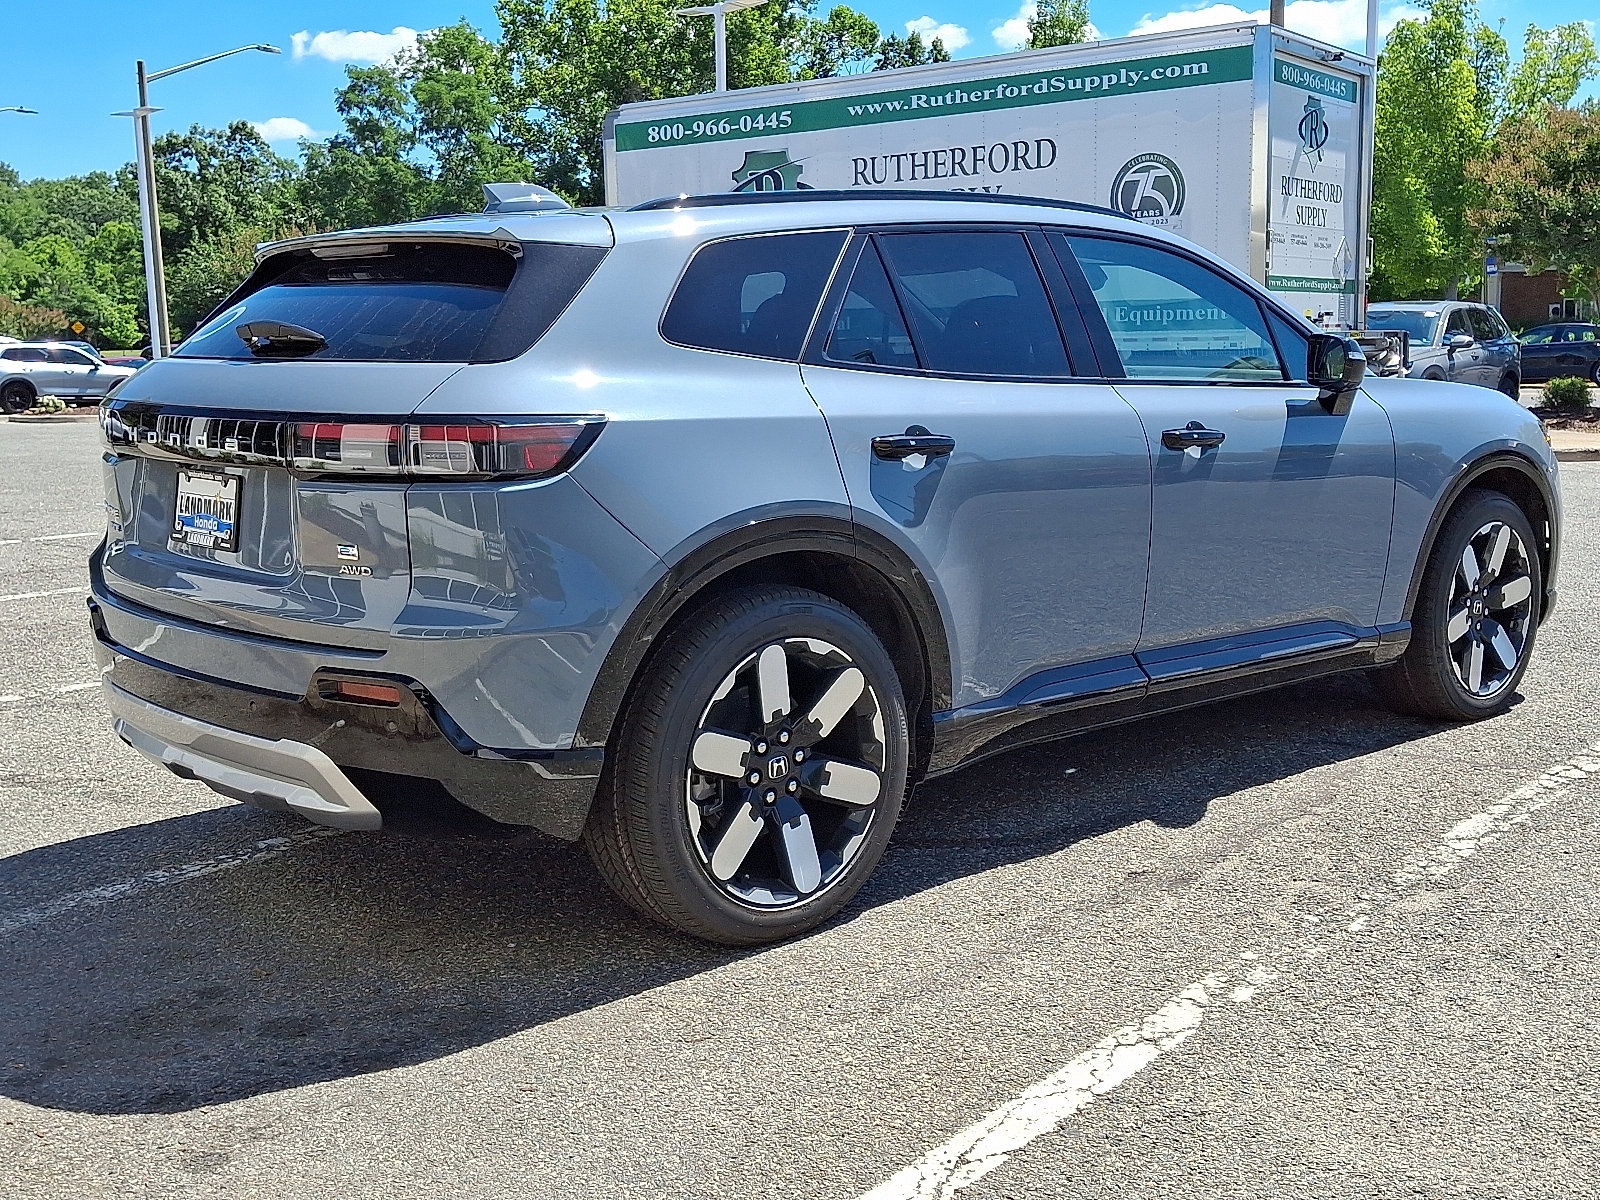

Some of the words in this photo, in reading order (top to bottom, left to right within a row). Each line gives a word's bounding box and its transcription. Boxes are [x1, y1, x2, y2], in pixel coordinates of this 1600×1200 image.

[847, 62, 1209, 117] www.RutherfordSupply.com
[1282, 64, 1347, 97] 800-966-0445
[647, 110, 793, 143] 800-966-0445
[851, 137, 1058, 187] RUTHERFORD
[1127, 154, 1169, 168] CELEBRATING
[1280, 175, 1343, 204] RUTHERFORD
[1131, 209, 1160, 218] YEARS
[1296, 204, 1328, 227] SUPPLY
[179, 494, 233, 522] LANDMARK
[194, 515, 218, 530] Honda
[339, 565, 373, 576] AWD
